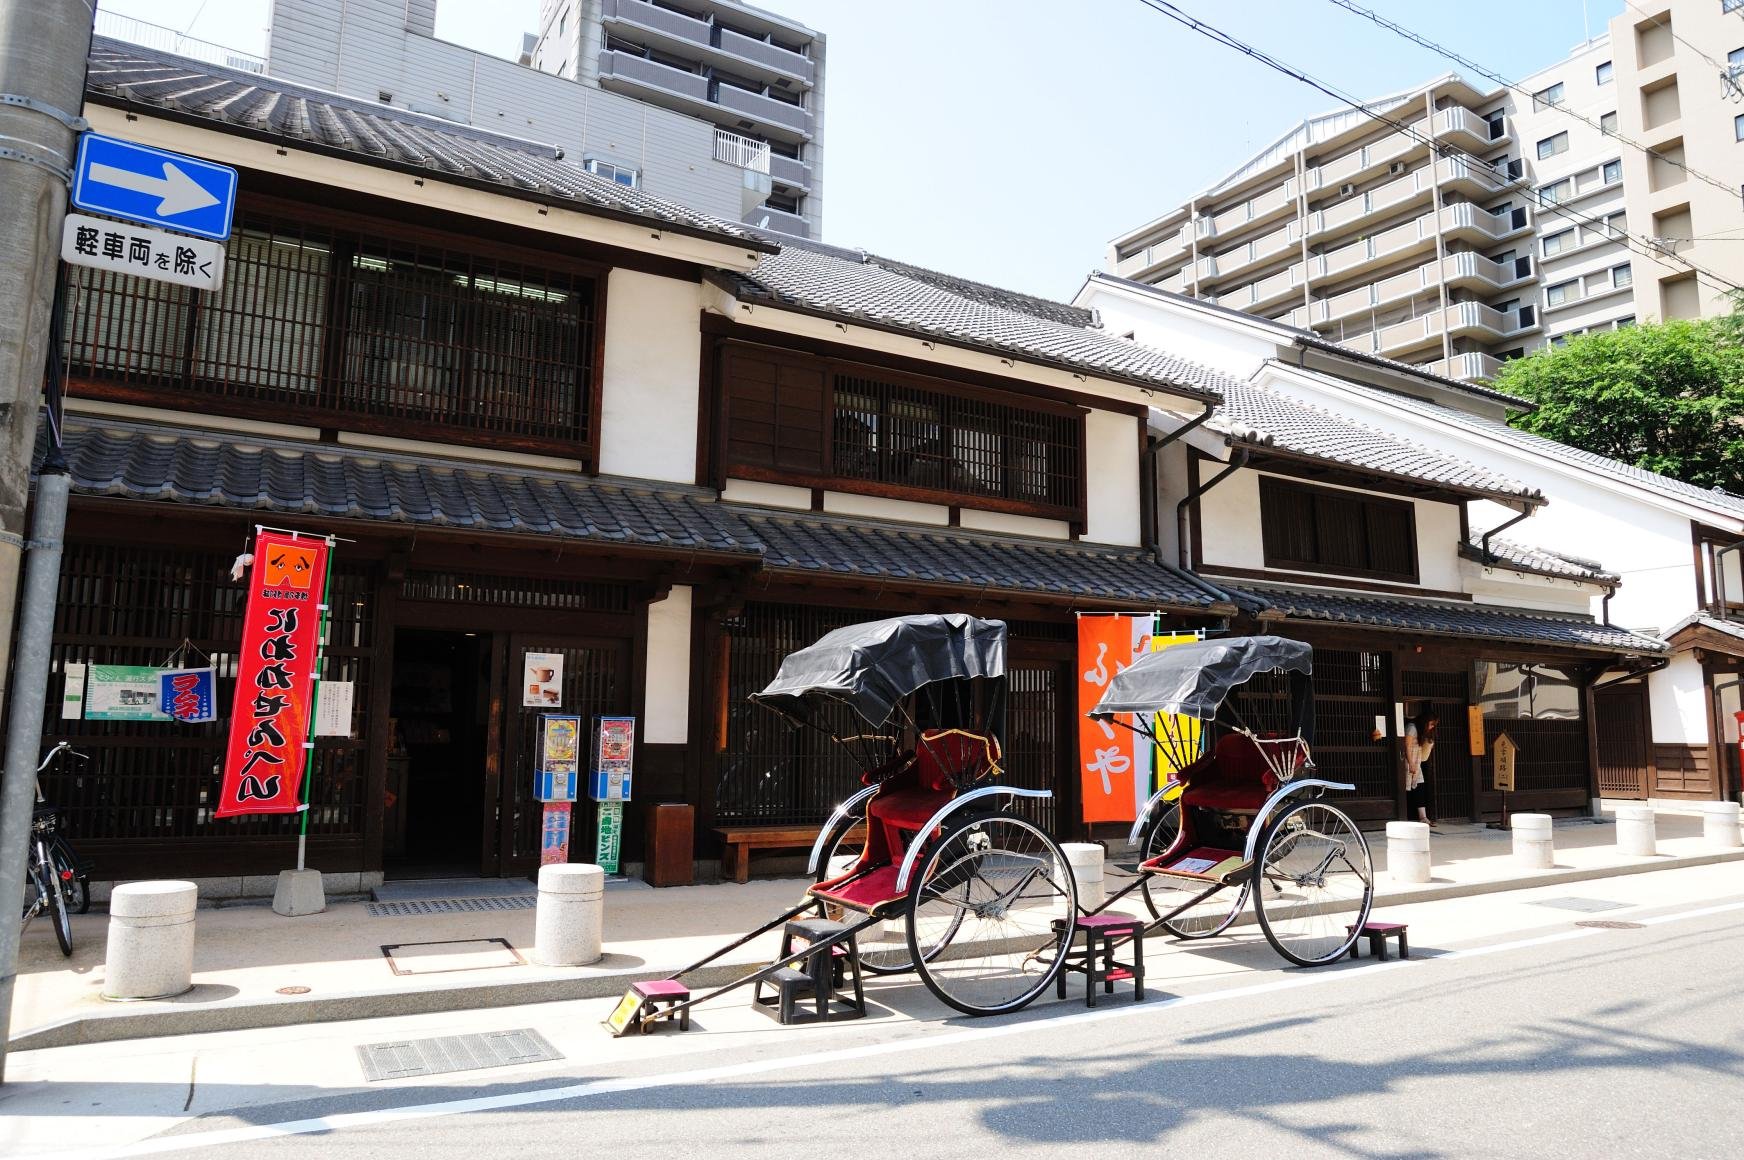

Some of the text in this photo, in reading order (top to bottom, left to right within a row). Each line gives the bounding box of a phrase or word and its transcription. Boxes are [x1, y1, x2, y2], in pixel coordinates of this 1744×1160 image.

[75, 225, 212, 279] 軽車両を除く
[172, 674, 200, 719] ラムネ
